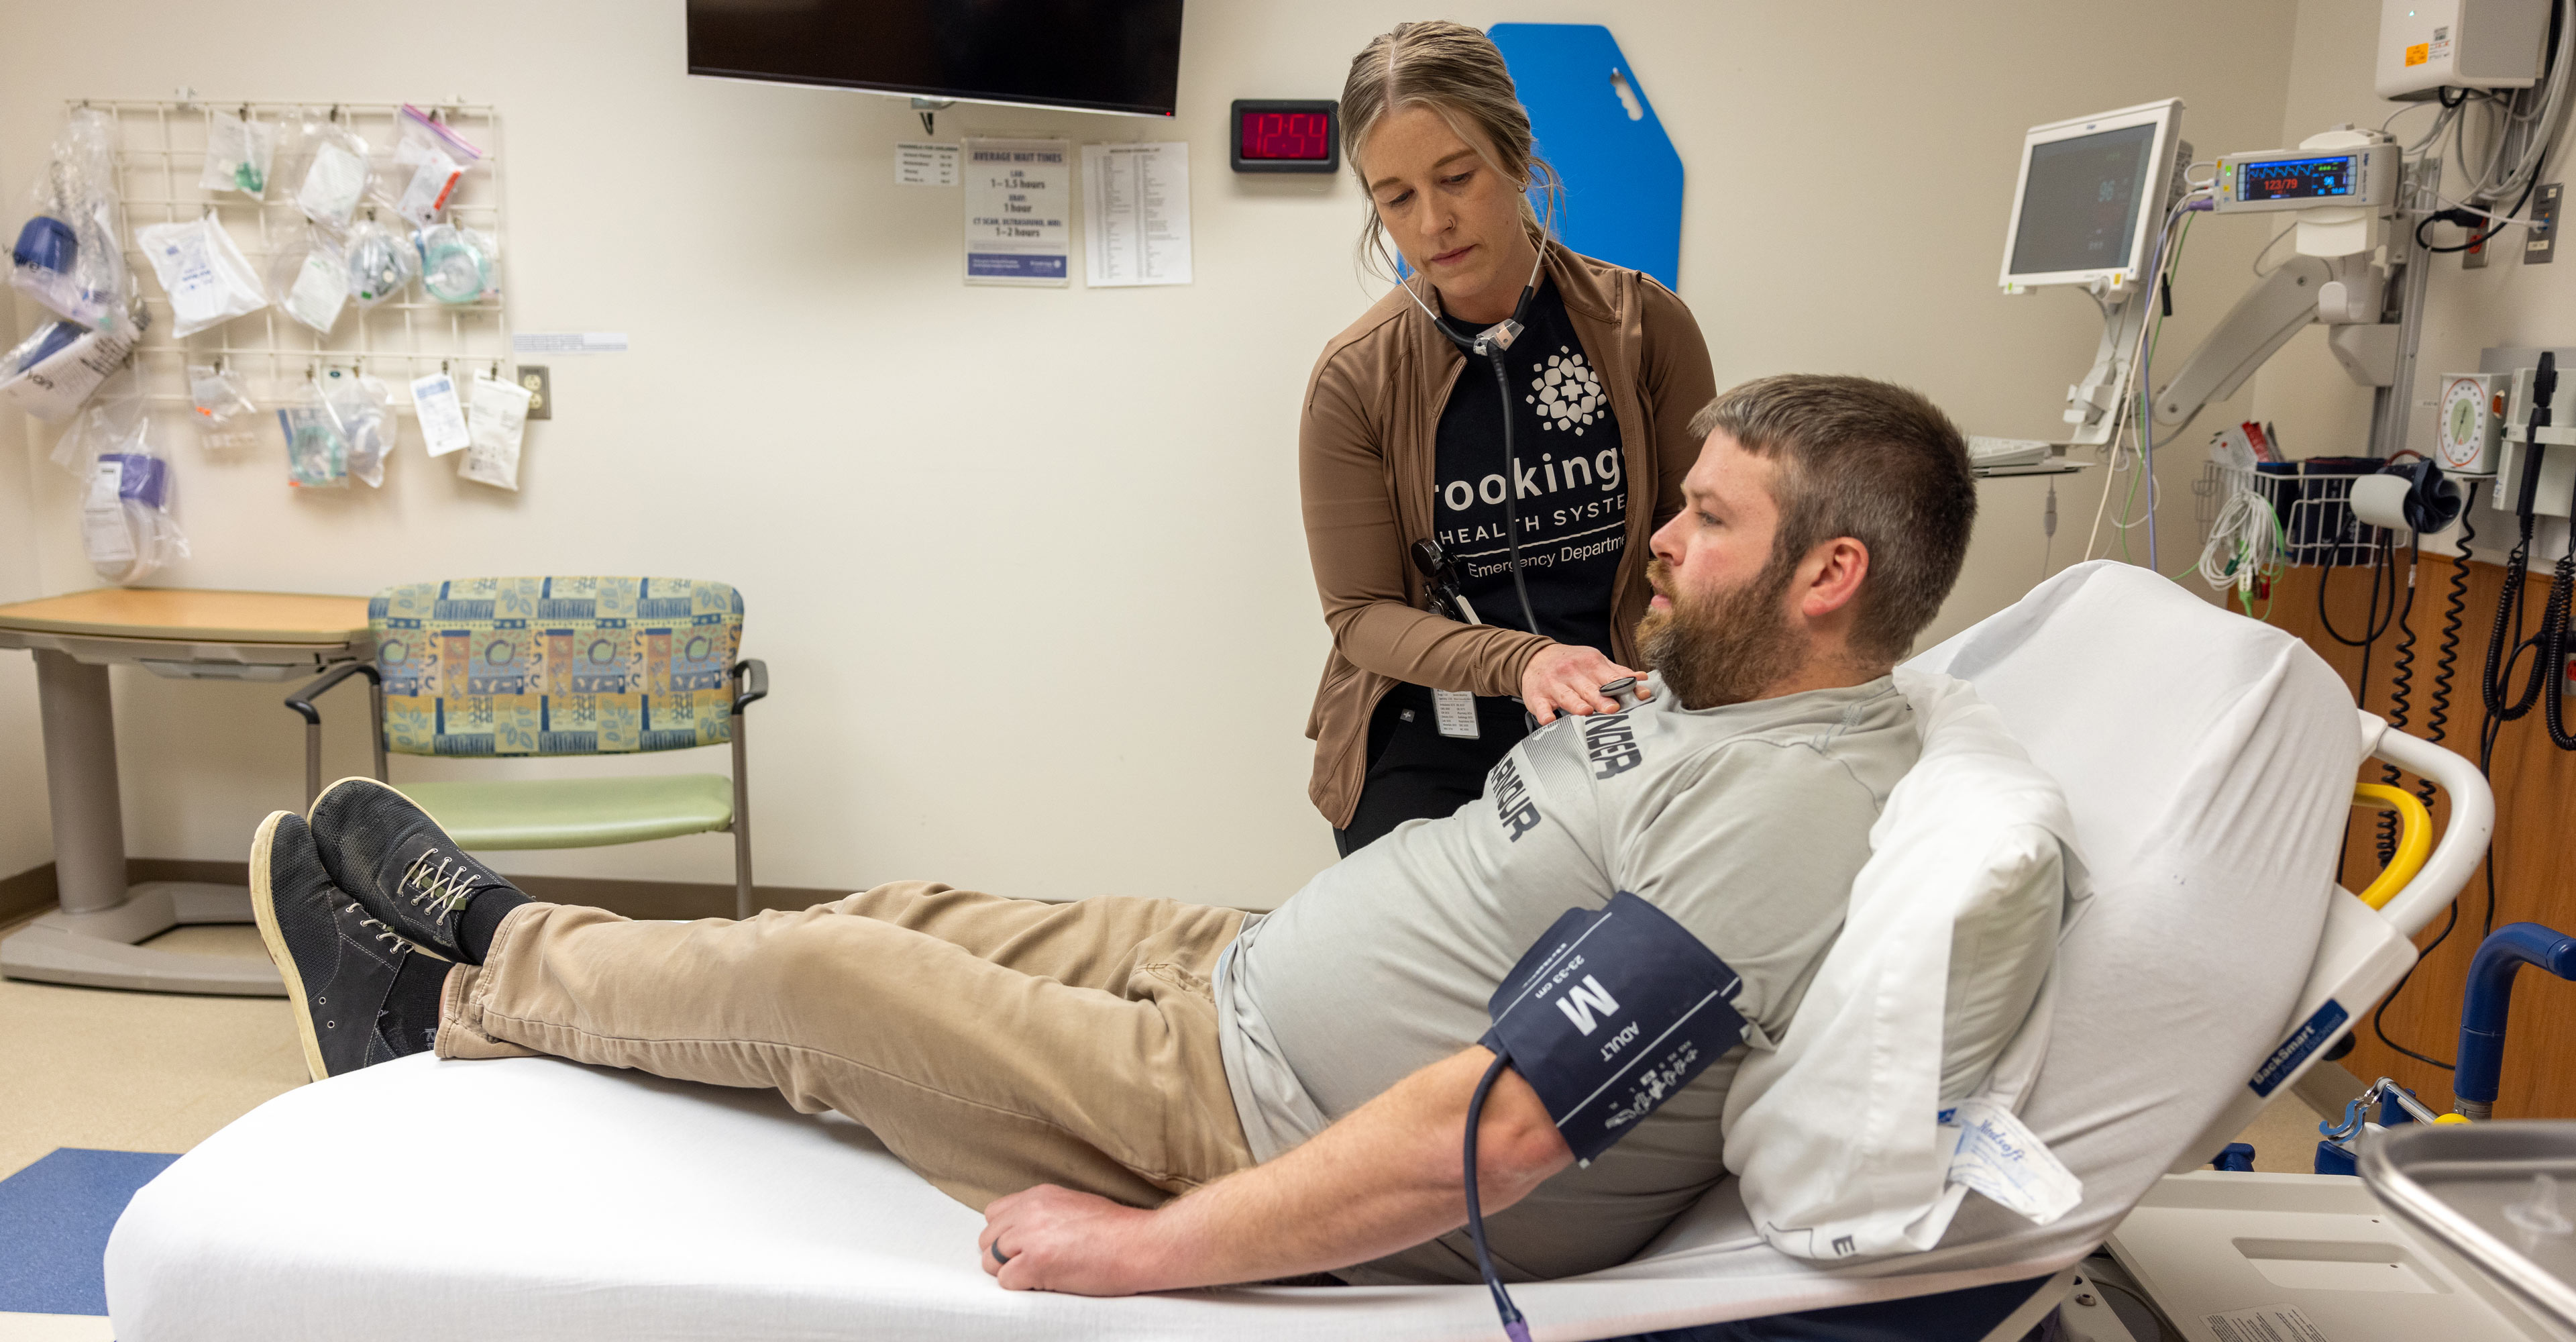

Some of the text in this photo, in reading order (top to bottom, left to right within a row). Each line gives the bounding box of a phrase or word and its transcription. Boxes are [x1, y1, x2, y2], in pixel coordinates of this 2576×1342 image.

[1256, 113, 1327, 158] 12:54
[1020, 179, 1045, 189] hours
[2264, 178, 2298, 191] 123/79
[1010, 204, 1032, 212] hour
[1014, 228, 1040, 237] hours
[1435, 447, 1625, 511] ooking
[1440, 493, 1625, 545] HEALH SYSTE
[1561, 534, 1625, 562] Departme
[1585, 713, 1642, 780] NDER
[1552, 954, 1585, 984] 23-33
[1535, 982, 1553, 998] cm
[1556, 974, 1620, 1037] M
[1600, 1021, 1640, 1062] ADULT
[2254, 1025, 2314, 1084] BackSmart
